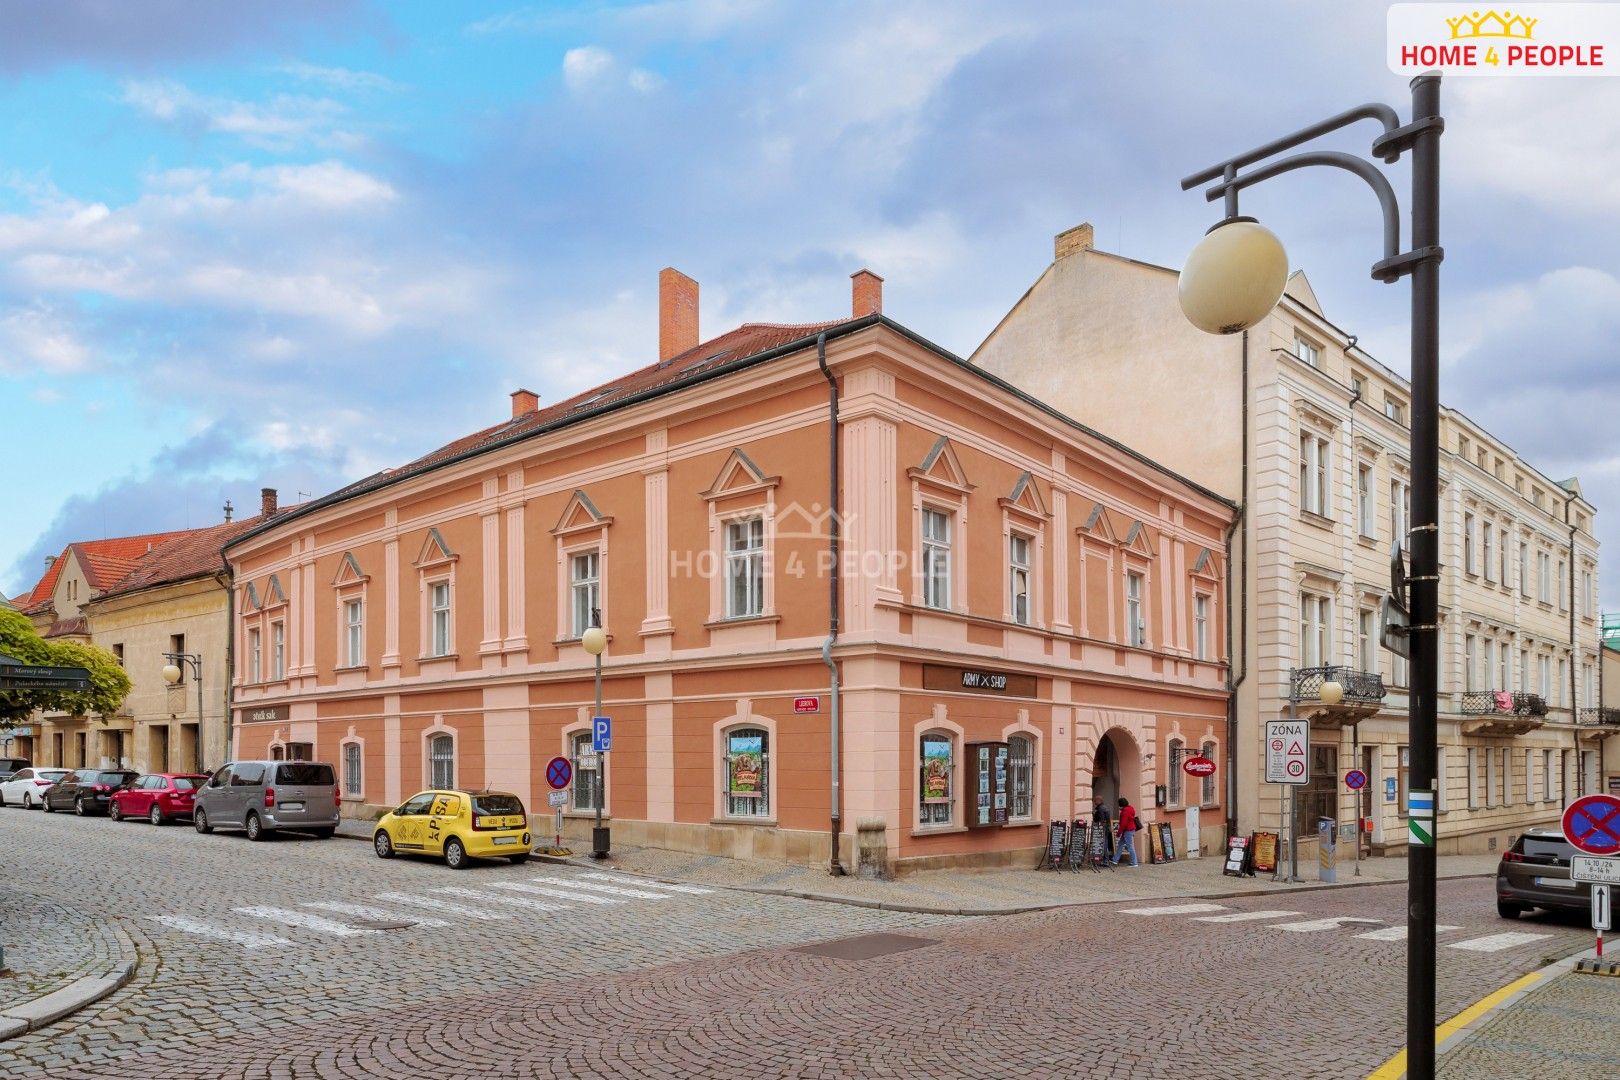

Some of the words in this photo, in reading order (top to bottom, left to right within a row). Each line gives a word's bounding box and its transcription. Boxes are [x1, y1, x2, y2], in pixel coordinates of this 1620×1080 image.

[962, 672, 980, 687] ARMY
[990, 675, 1006, 689] SHOP
[596, 721, 608, 742] P
[1271, 724, 1303, 736] ZÓNA
[1291, 764, 1300, 773] 30
